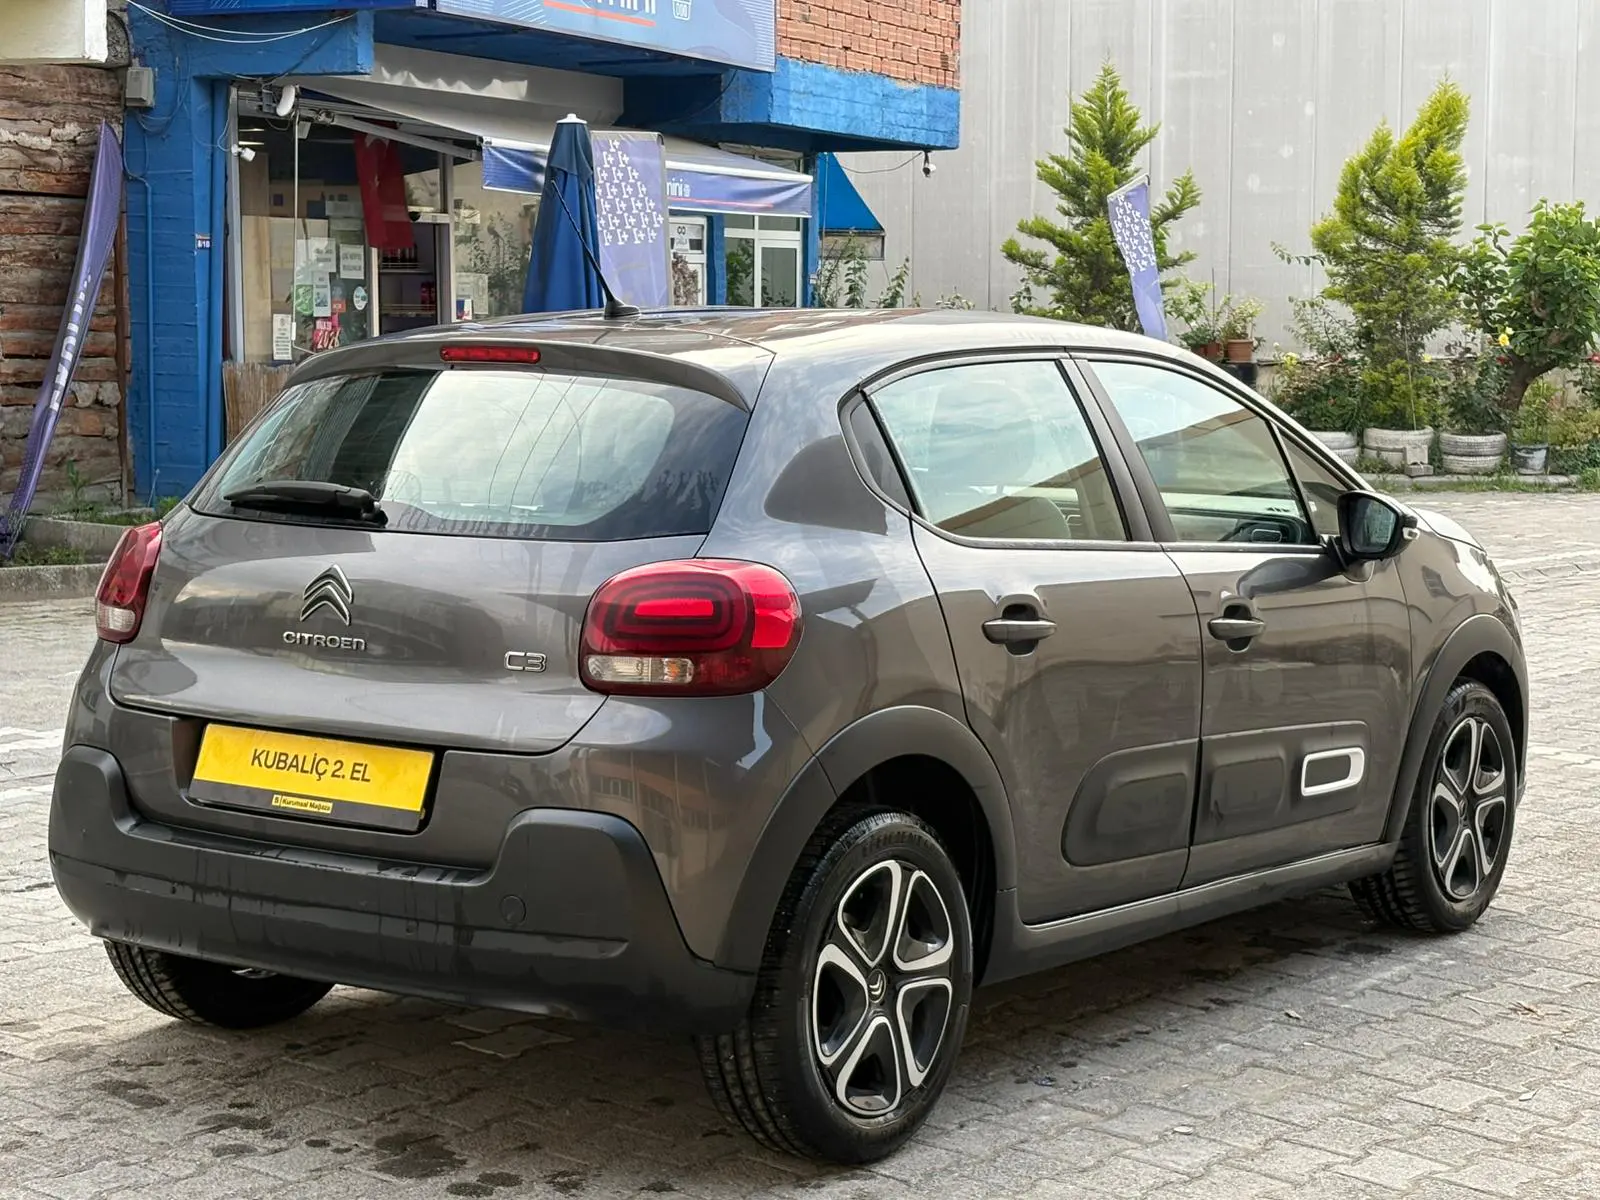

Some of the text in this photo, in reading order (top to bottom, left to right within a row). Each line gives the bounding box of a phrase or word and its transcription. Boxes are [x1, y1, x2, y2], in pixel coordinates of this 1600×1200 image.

[504, 651, 547, 672] C3
[251, 748, 371, 782] KUBALİÇ 2. EL
[282, 798, 309, 808] Kurumsal
